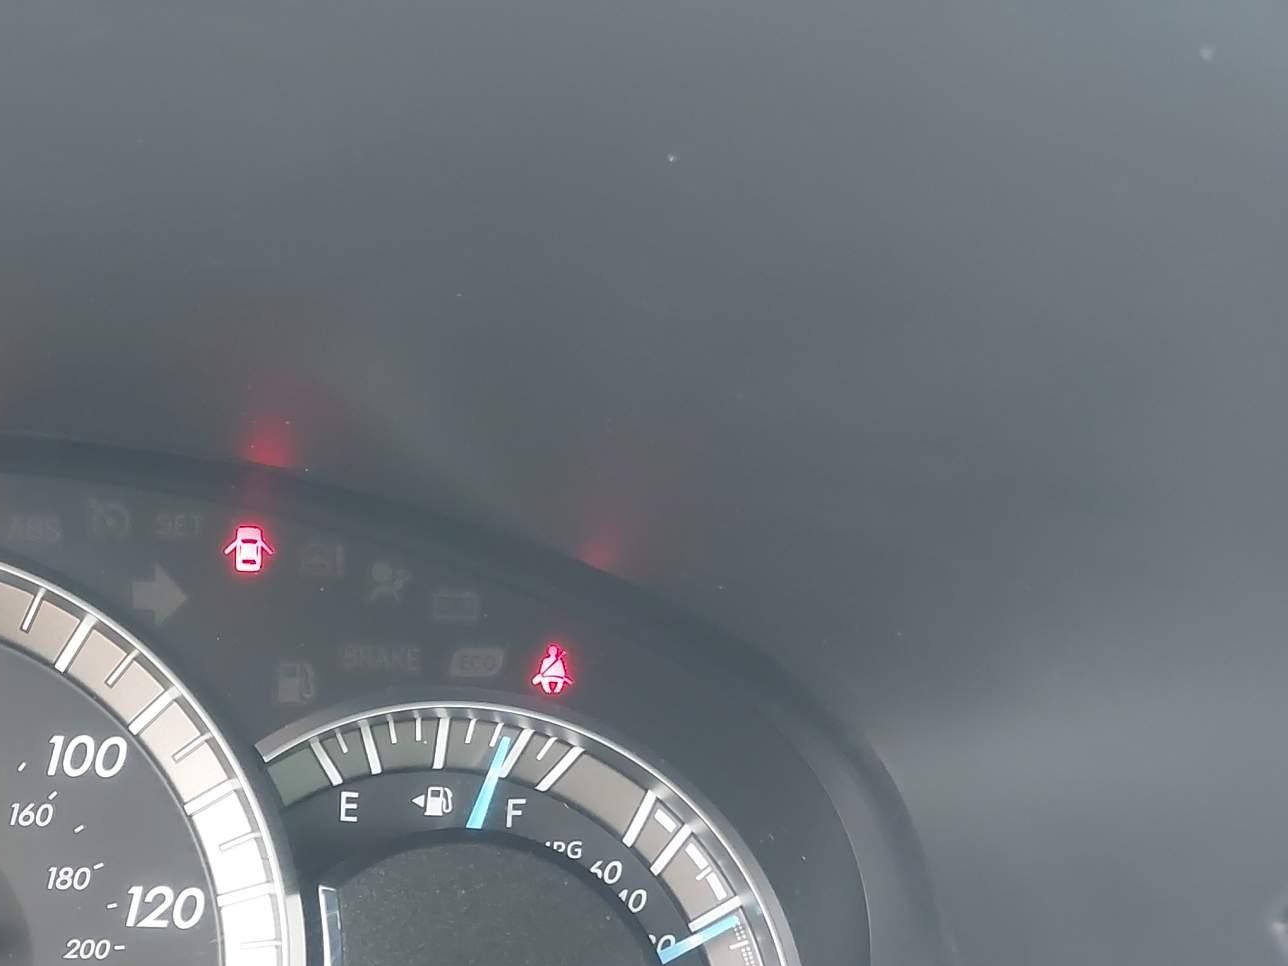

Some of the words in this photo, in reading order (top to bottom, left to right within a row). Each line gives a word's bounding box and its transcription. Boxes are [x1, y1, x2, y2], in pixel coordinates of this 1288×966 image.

[48, 735, 126, 777] 100
[11, 803, 53, 827] 160
[340, 792, 359, 822] E
[507, 799, 526, 828] F
[546, 841, 582, 858] PG
[48, 867, 90, 890] 180
[126, 886, 205, 929] 120
[64, 939, 110, 959] 200
